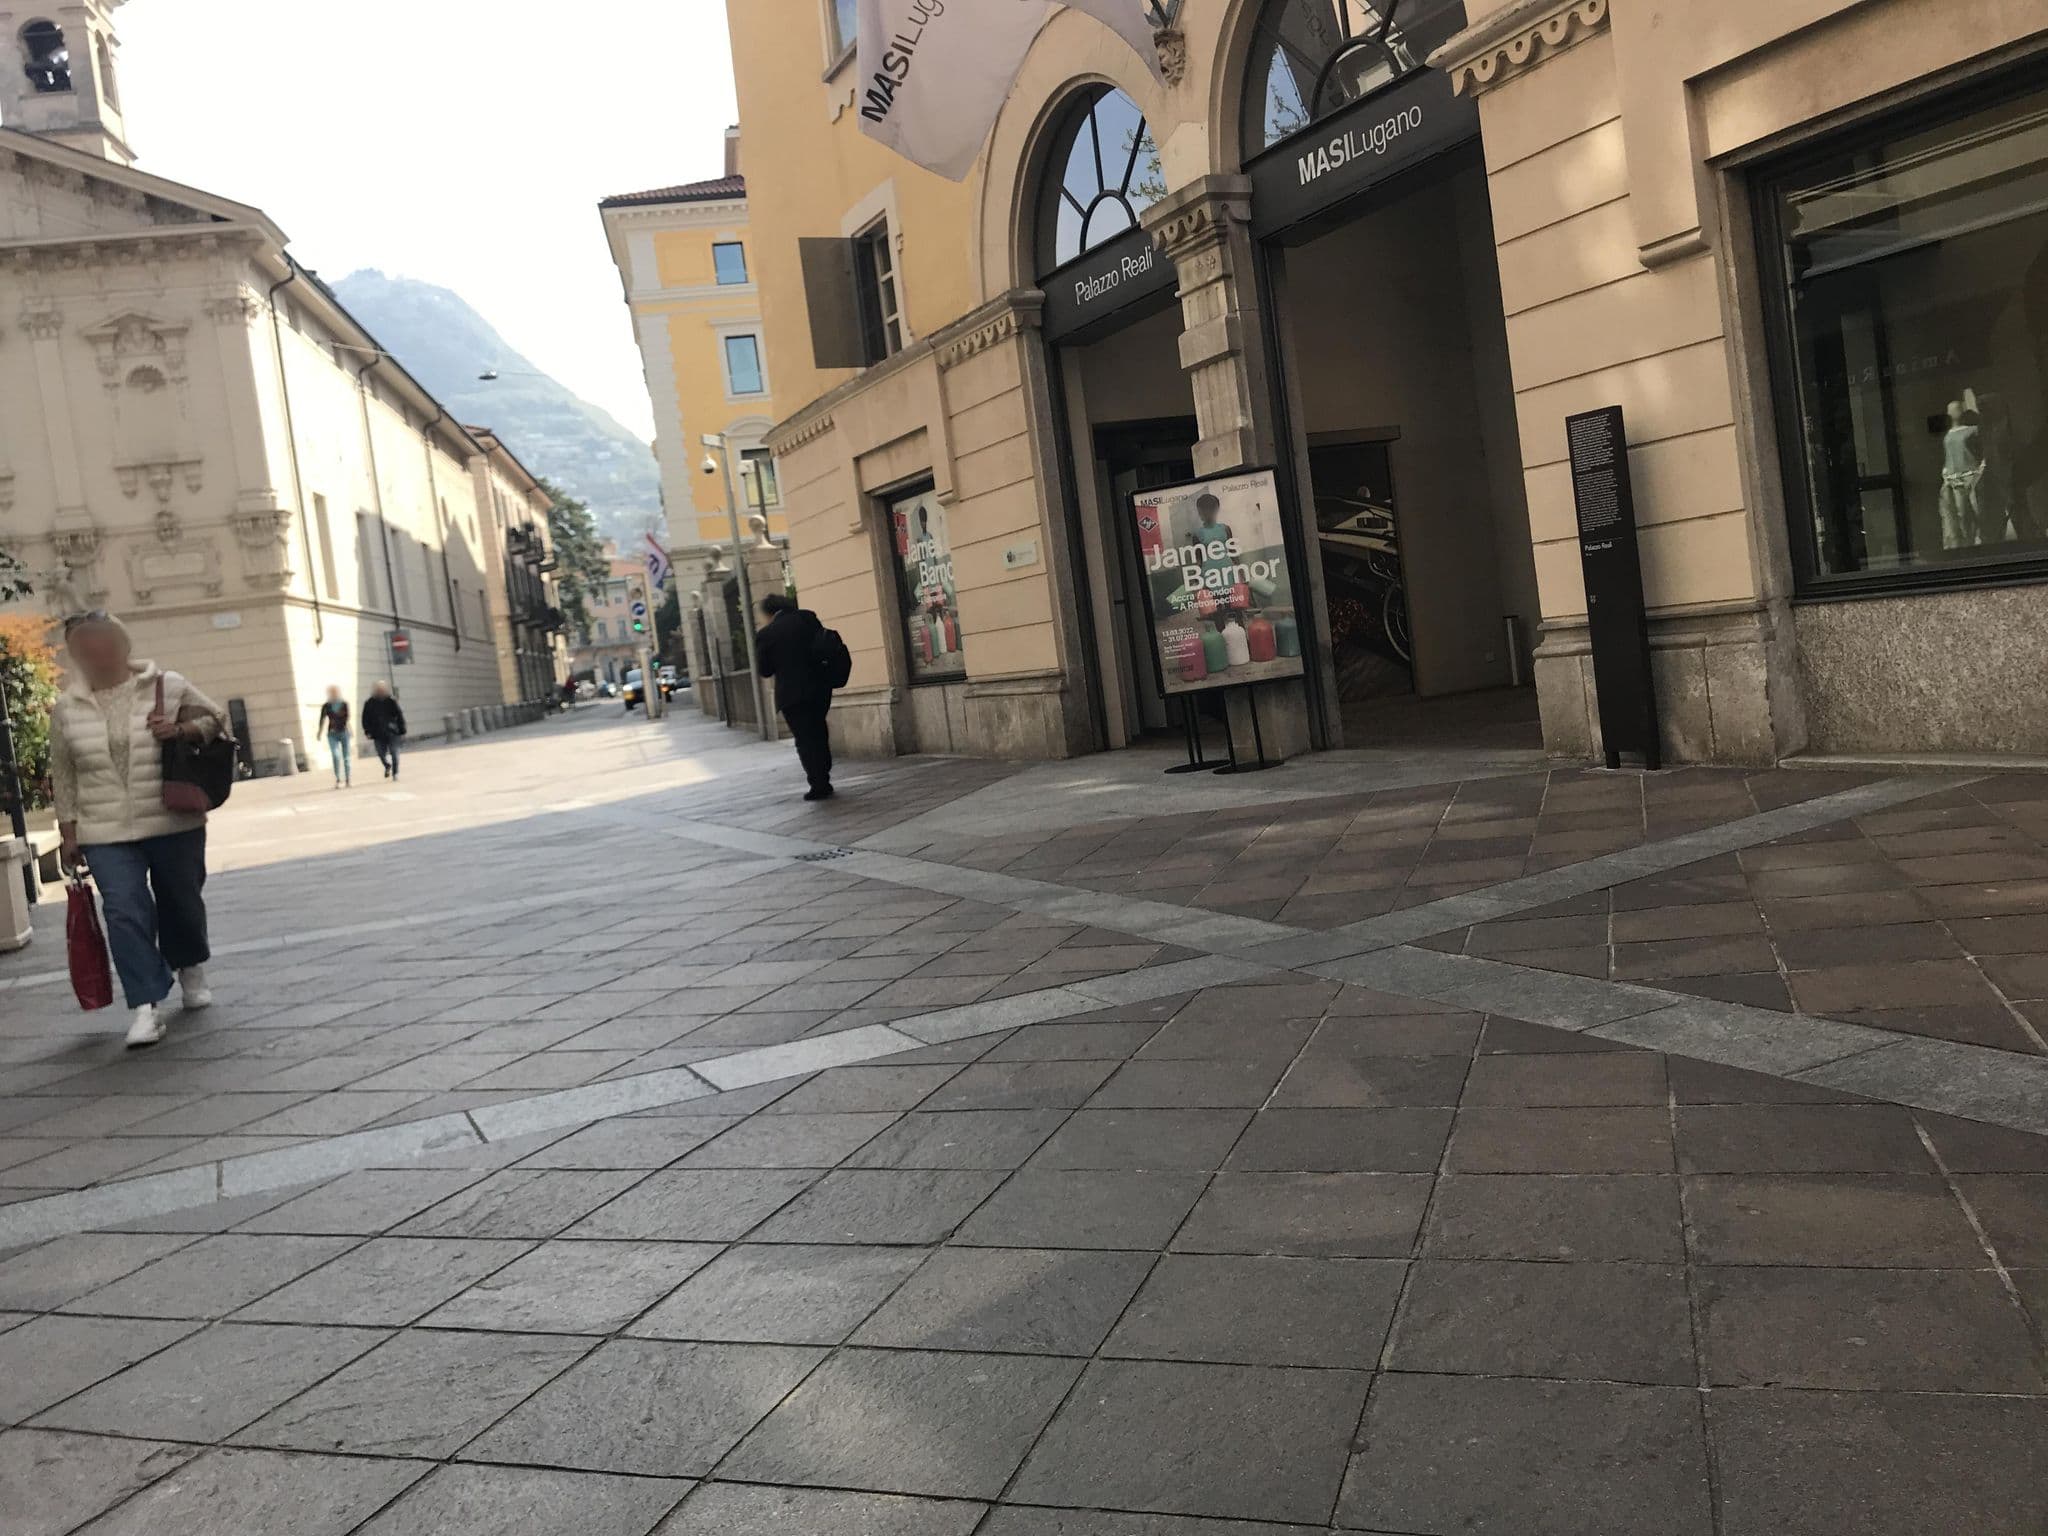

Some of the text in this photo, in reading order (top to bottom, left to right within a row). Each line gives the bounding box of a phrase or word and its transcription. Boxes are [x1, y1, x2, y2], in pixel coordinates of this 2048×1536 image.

[1298, 105, 1422, 186] MASILugano
[1075, 245, 1154, 306] Palazzo Reali
[1151, 537, 1241, 571] James
[1182, 558, 1280, 592] Barnor
[1171, 593, 1195, 604] Accra
[1203, 587, 1235, 599] London
[1180, 602, 1187, 611] A
[1188, 594, 1245, 611] Retrospective
